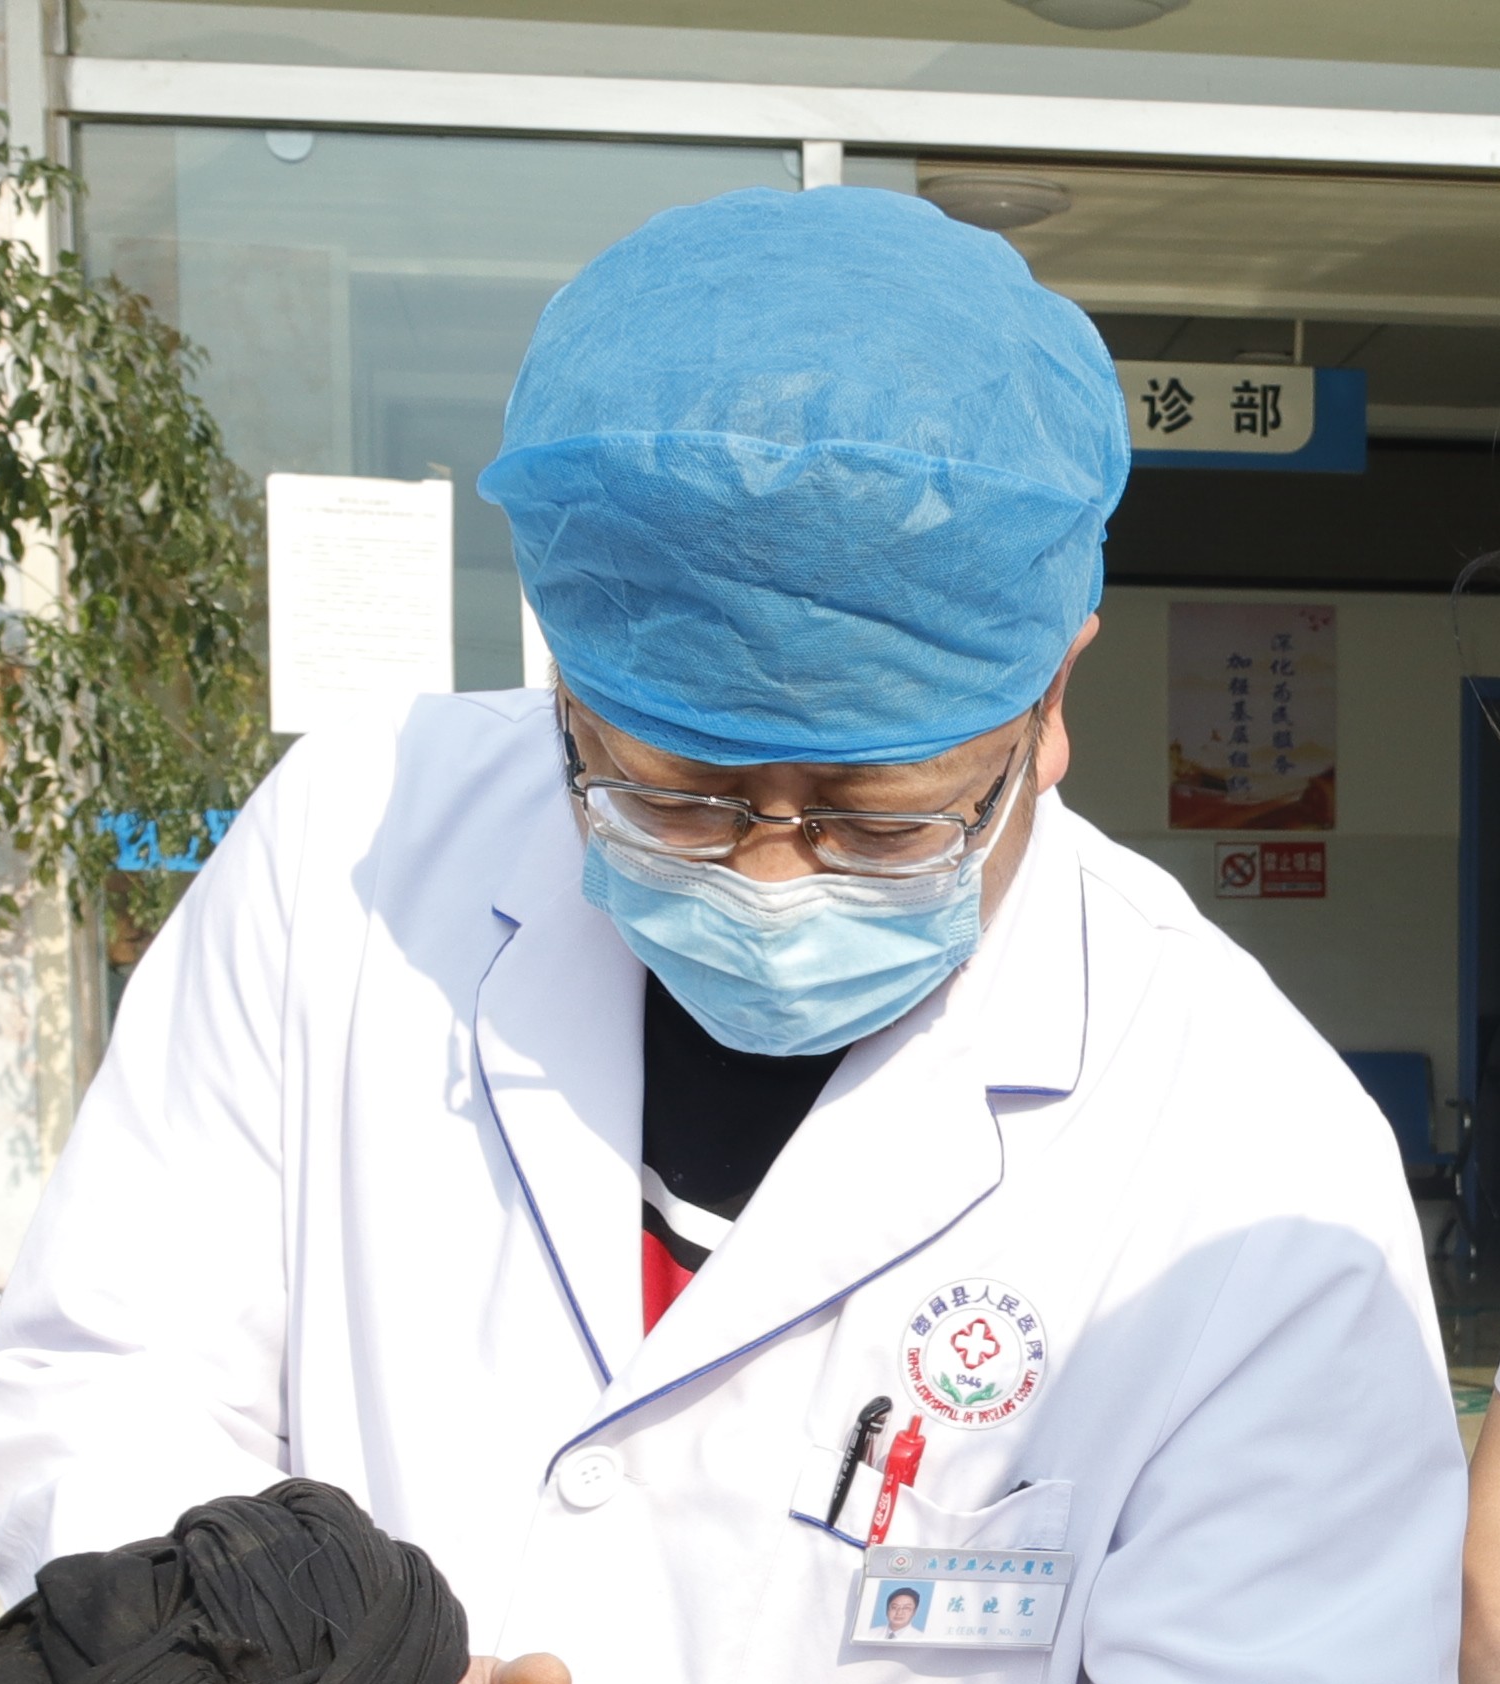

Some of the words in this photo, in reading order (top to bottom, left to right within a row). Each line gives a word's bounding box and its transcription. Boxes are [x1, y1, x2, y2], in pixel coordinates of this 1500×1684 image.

[1141, 377, 1282, 438] 诊部
[911, 1284, 1043, 1361] 德昌县人民医院
